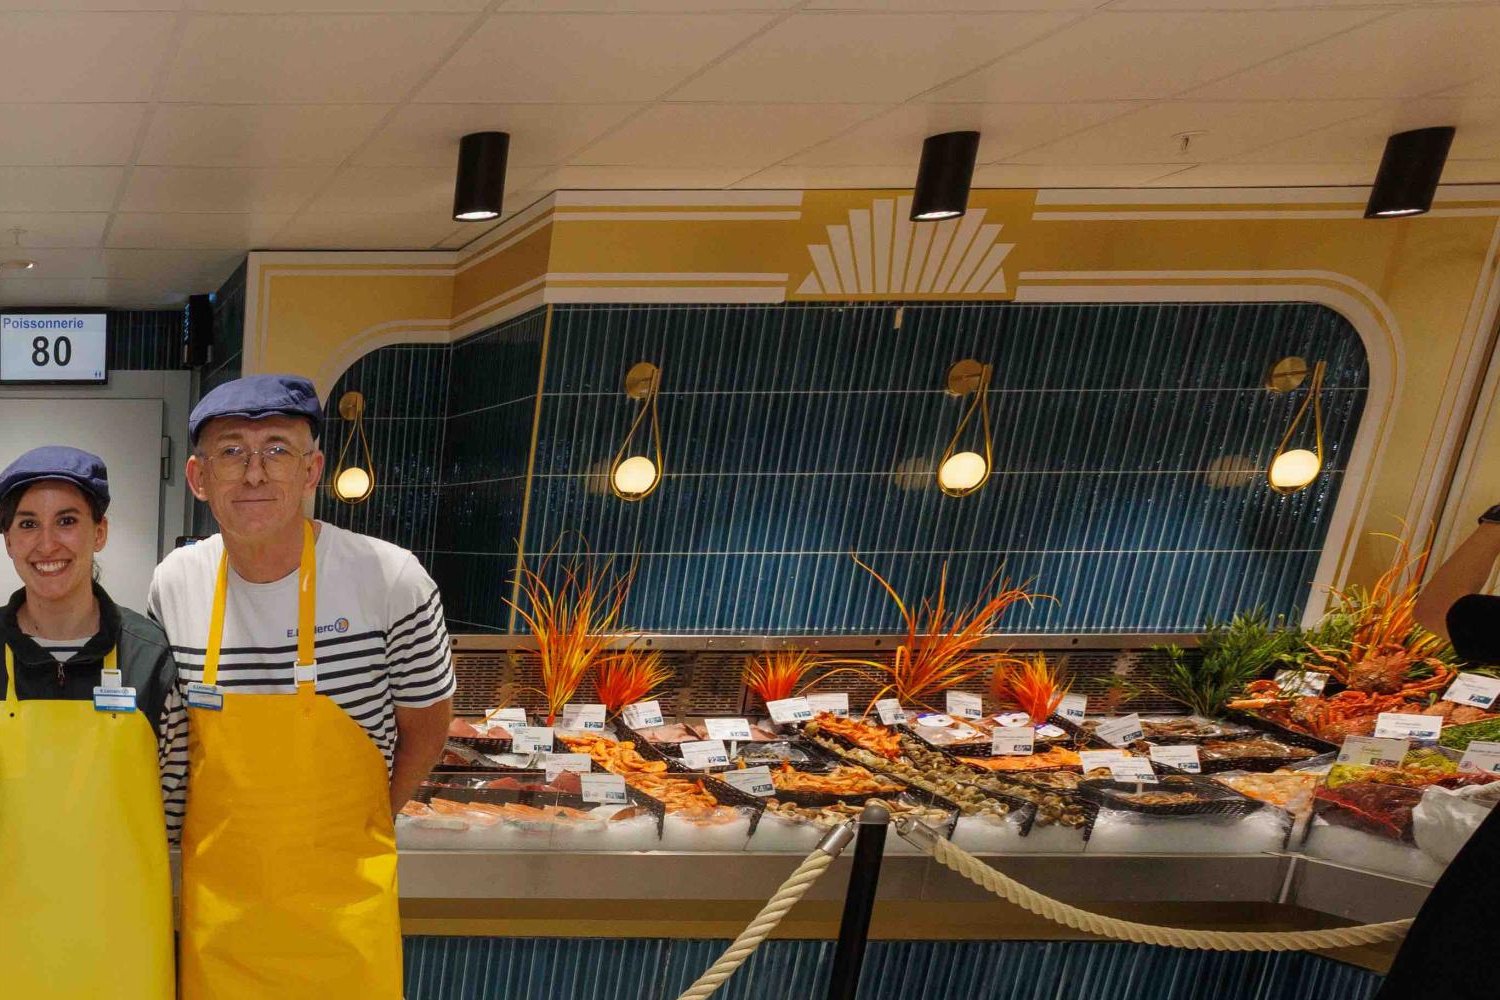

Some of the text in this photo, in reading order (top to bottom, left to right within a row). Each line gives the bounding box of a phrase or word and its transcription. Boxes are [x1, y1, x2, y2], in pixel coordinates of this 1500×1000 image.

[3, 317, 84, 329] Poissonnerie
[31, 335, 72, 367] 80
[286, 624, 334, 638] E.Llerc
